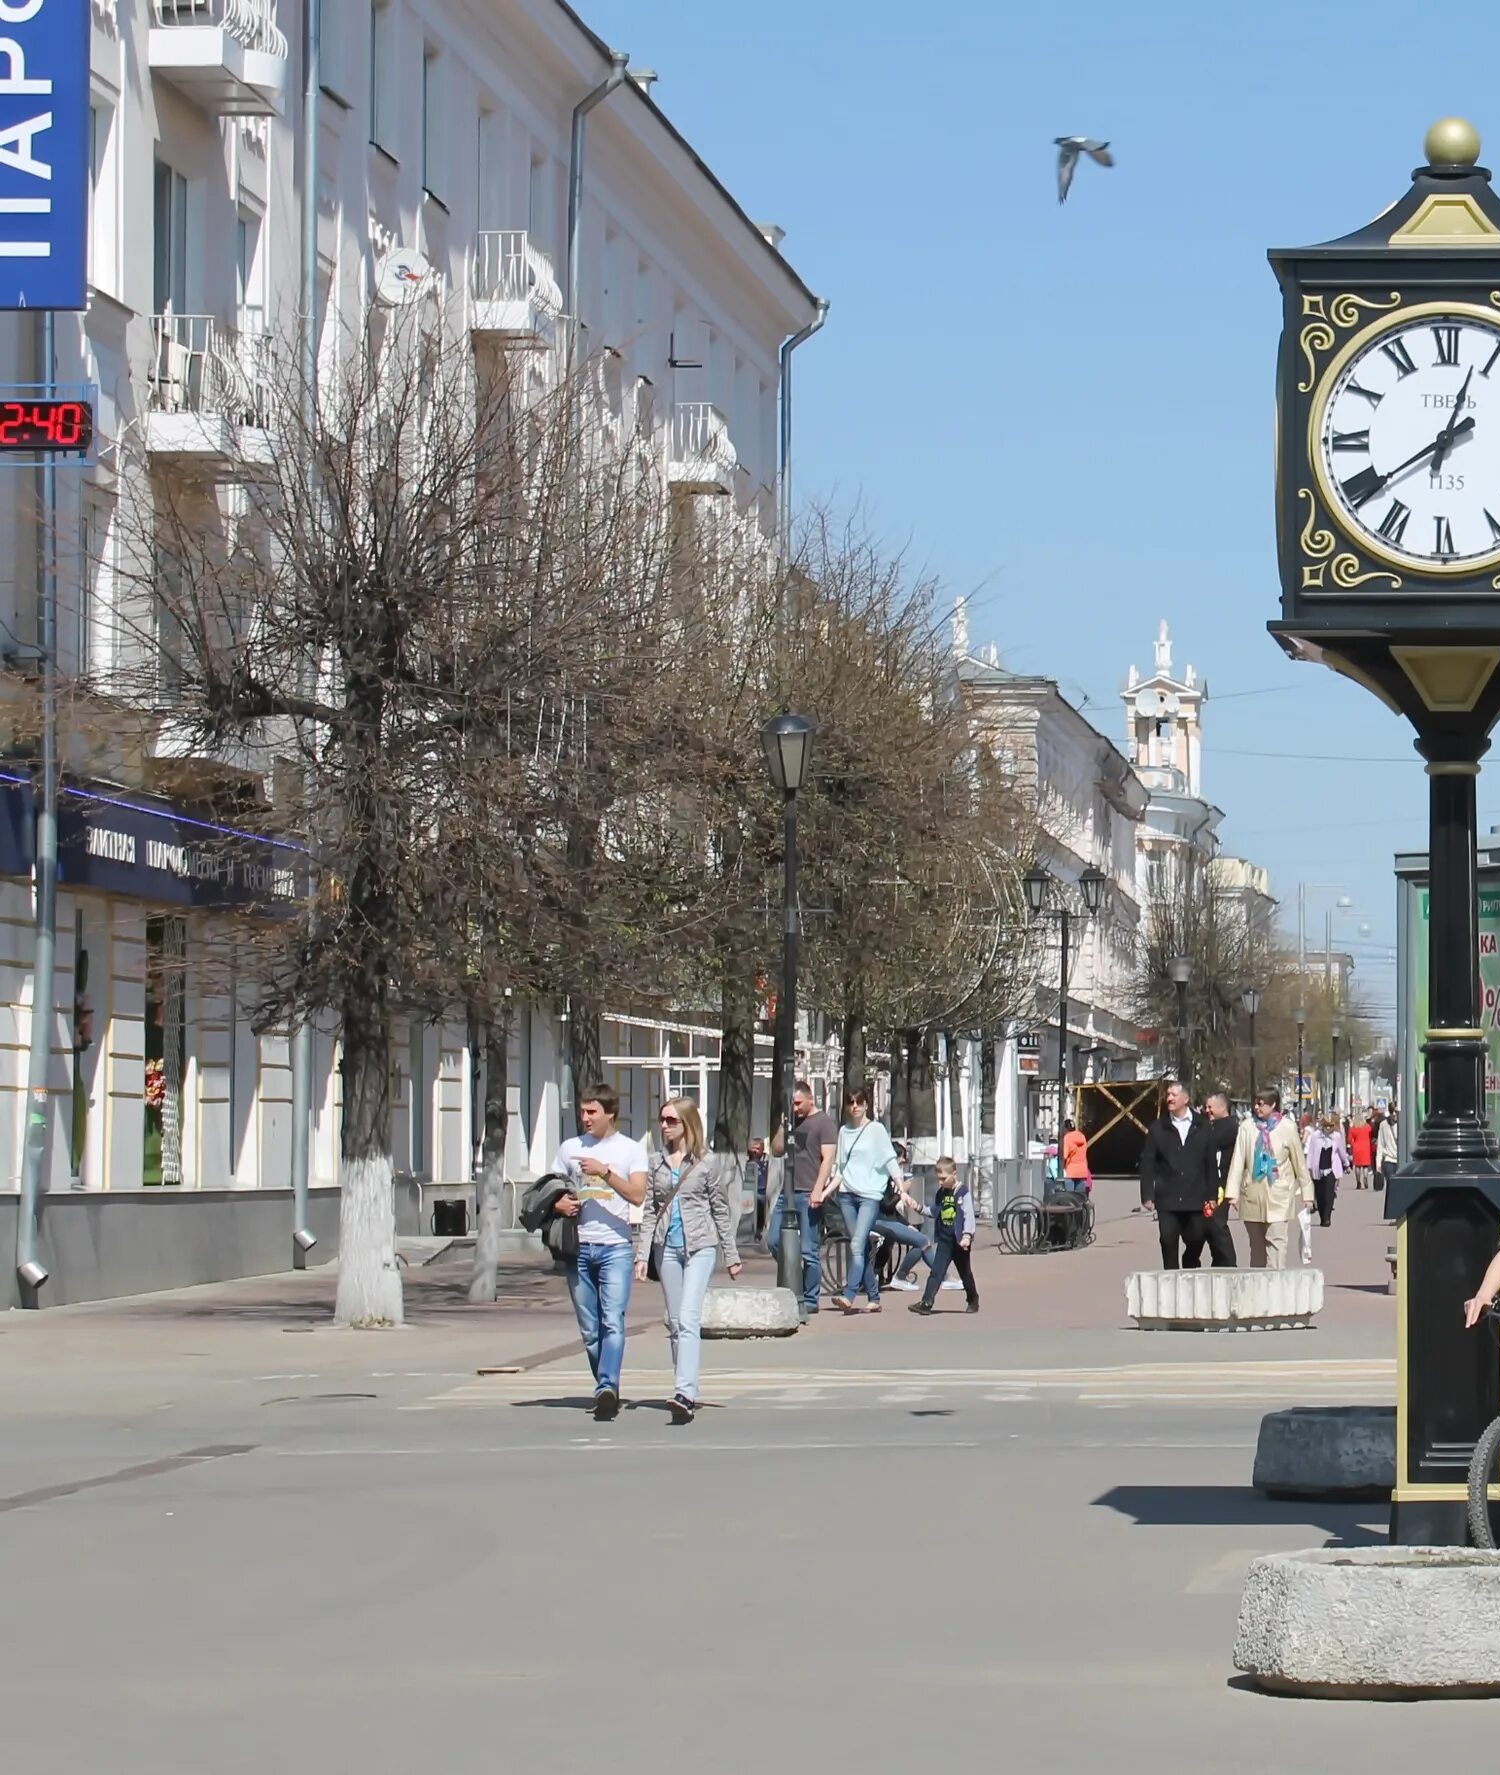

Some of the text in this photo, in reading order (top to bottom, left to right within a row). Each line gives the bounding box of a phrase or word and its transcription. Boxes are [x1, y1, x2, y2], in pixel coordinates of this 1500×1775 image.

[0, 0, 52, 257] ПАР
[1378, 335, 1418, 382] XI
[1430, 326, 1463, 367] XII
[1342, 373, 1385, 412] X
[1420, 394, 1477, 409] ТВЕЬ
[1332, 425, 1370, 455] IX
[1429, 474, 1465, 491] 1135
[1375, 498, 1412, 547] VII
[1430, 515, 1460, 556] VI
